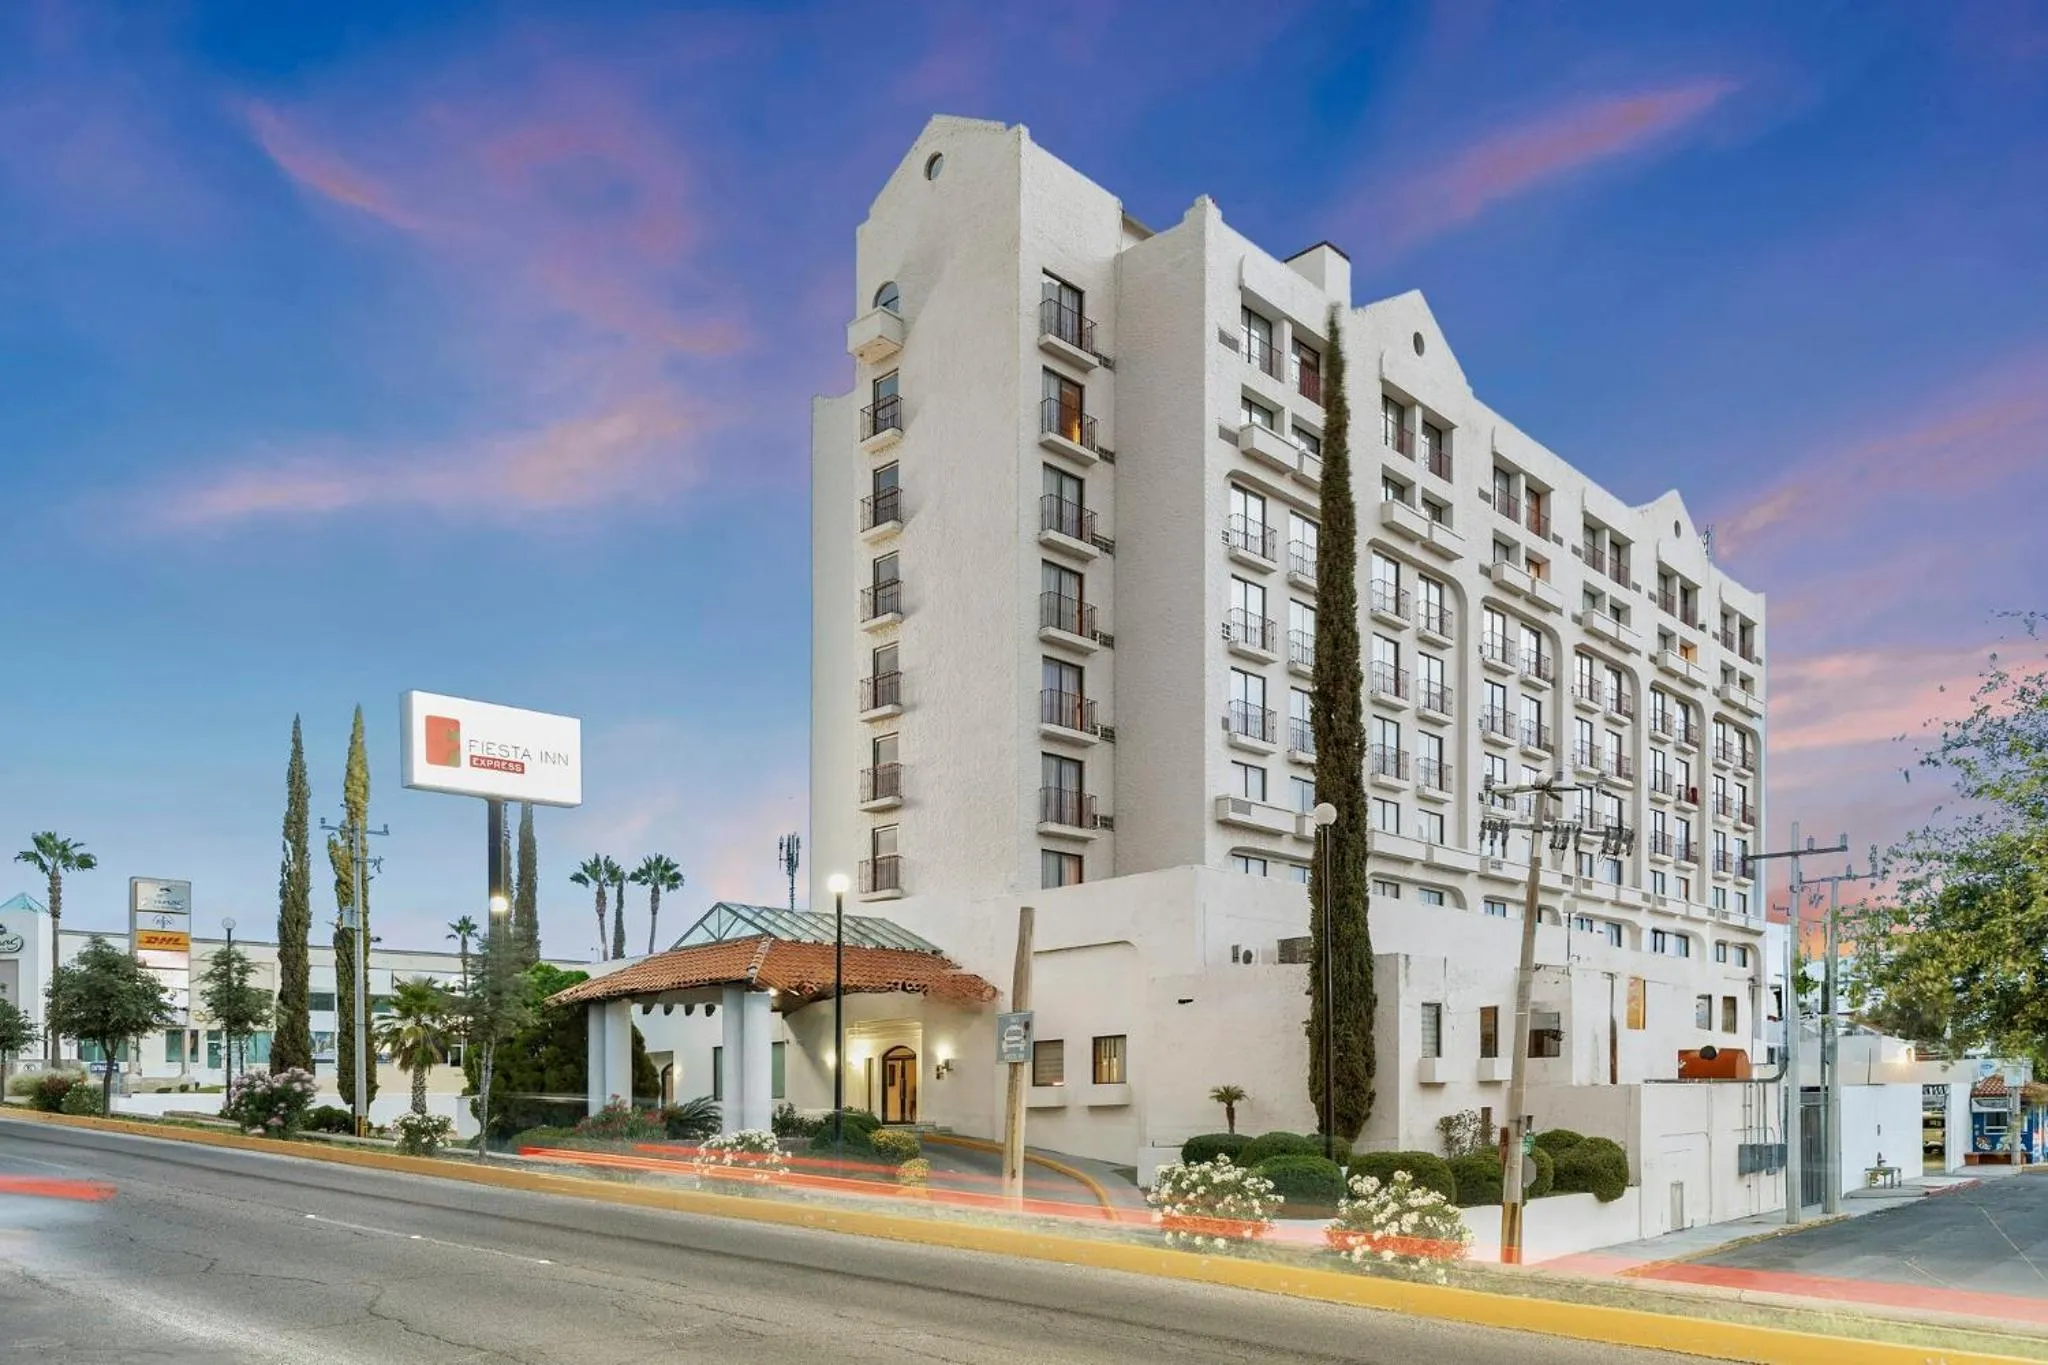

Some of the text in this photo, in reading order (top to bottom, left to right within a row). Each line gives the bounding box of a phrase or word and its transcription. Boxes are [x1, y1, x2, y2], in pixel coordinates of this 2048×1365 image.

[469, 739, 569, 767] FIESTA INN
[471, 757, 523, 773] EXPRESS
[145, 935, 183, 946] DHL
